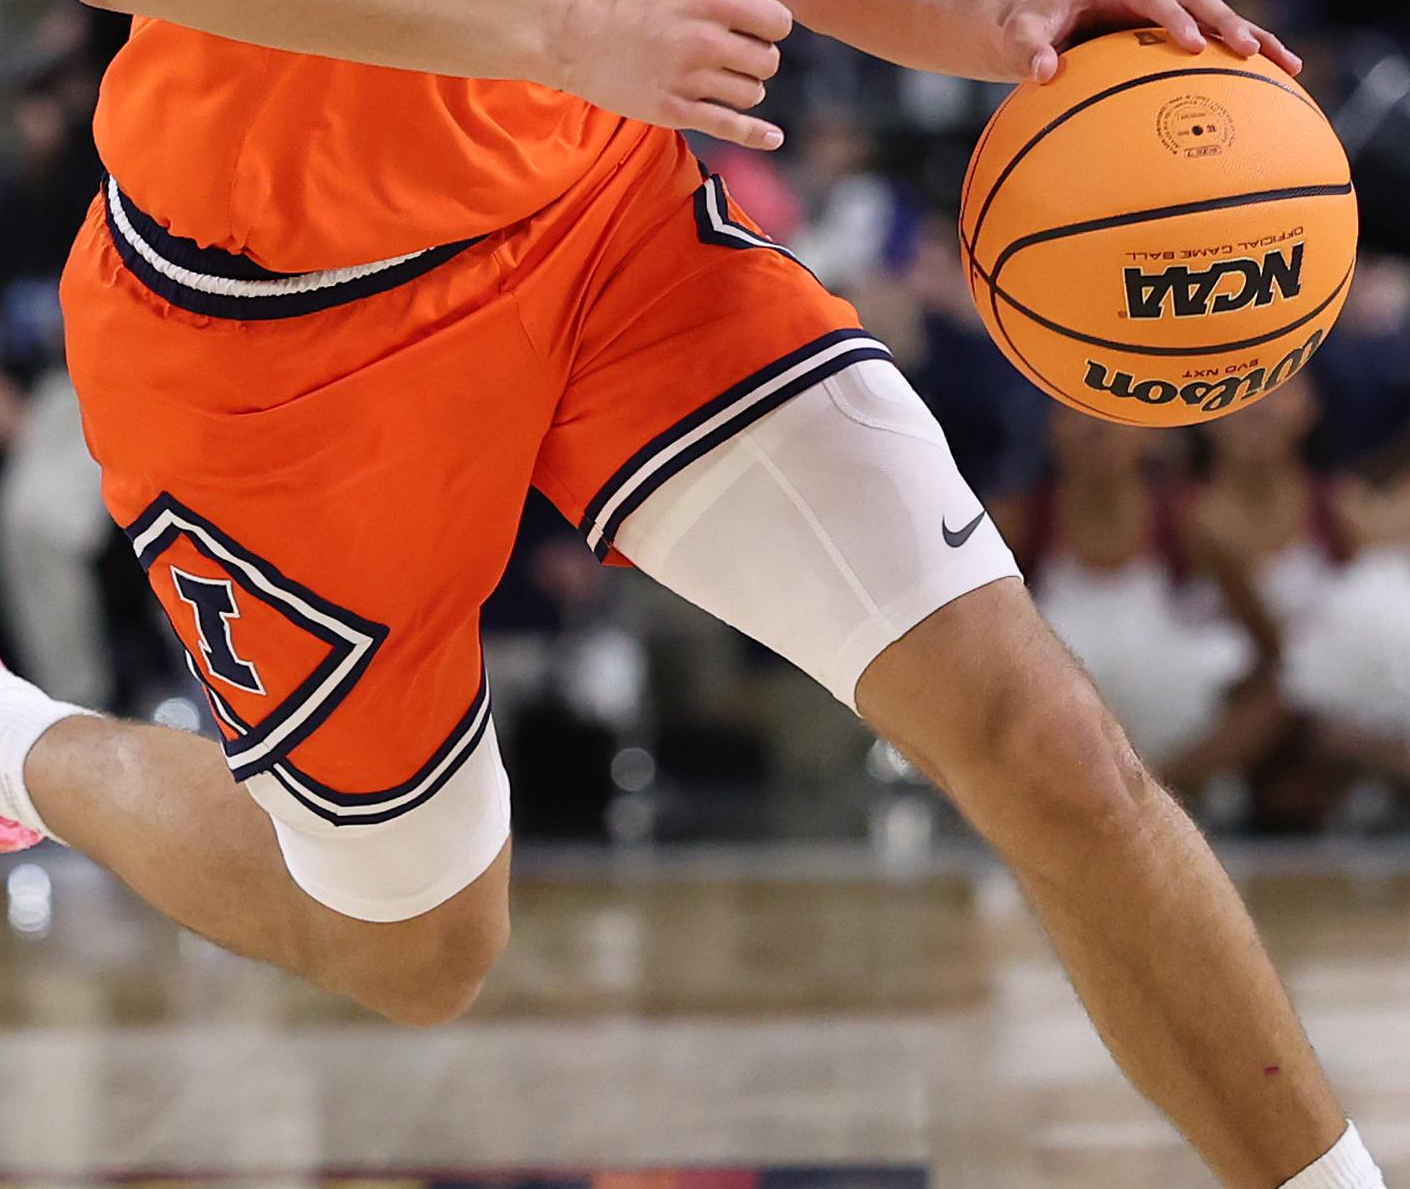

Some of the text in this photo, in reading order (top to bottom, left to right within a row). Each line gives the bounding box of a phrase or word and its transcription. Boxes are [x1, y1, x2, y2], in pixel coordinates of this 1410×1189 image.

[1125, 226, 1304, 261] OFFICIAL GAME BALL
[1123, 240, 1305, 320] NCAA
[1182, 358, 1259, 378] EVO NXT
[170, 564, 266, 696] I
